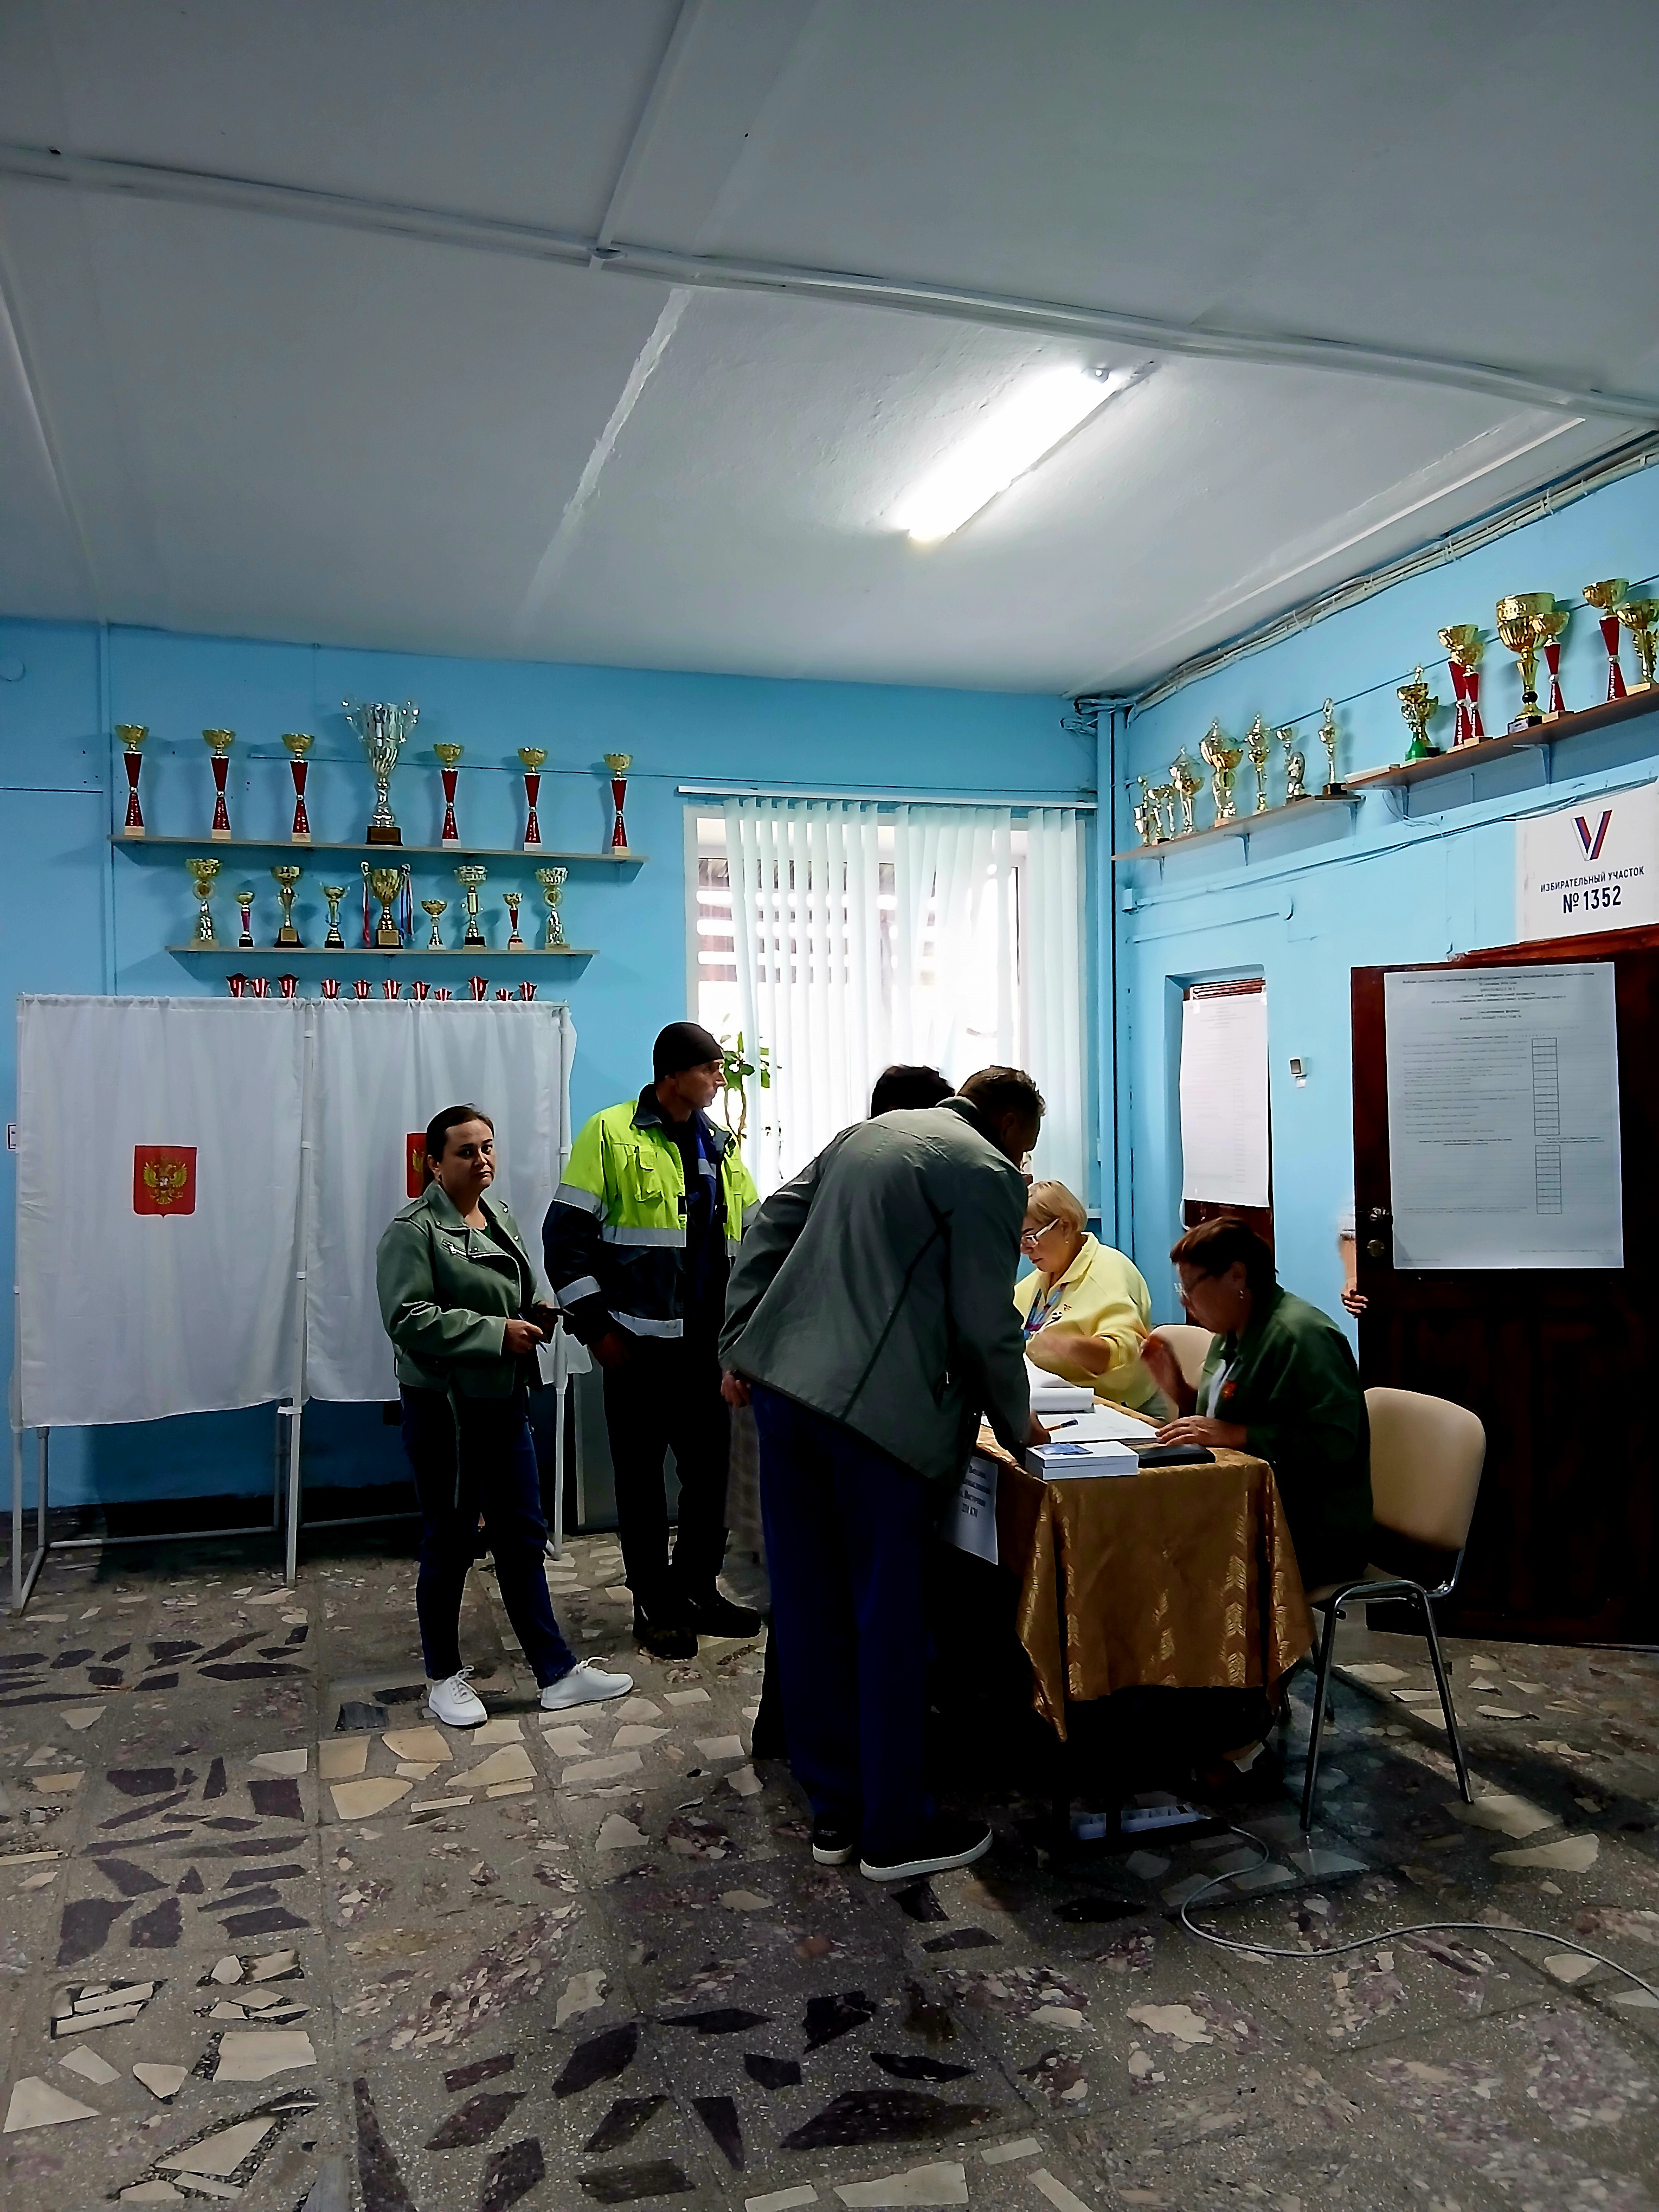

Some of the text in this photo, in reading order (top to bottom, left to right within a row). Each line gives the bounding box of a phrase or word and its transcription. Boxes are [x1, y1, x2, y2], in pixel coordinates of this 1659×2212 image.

[1540, 866, 1644, 892] ИЗБИРАТЕЛЬНЫЙ УЧАСТОК
[1563, 885, 1622, 914] № 1352
